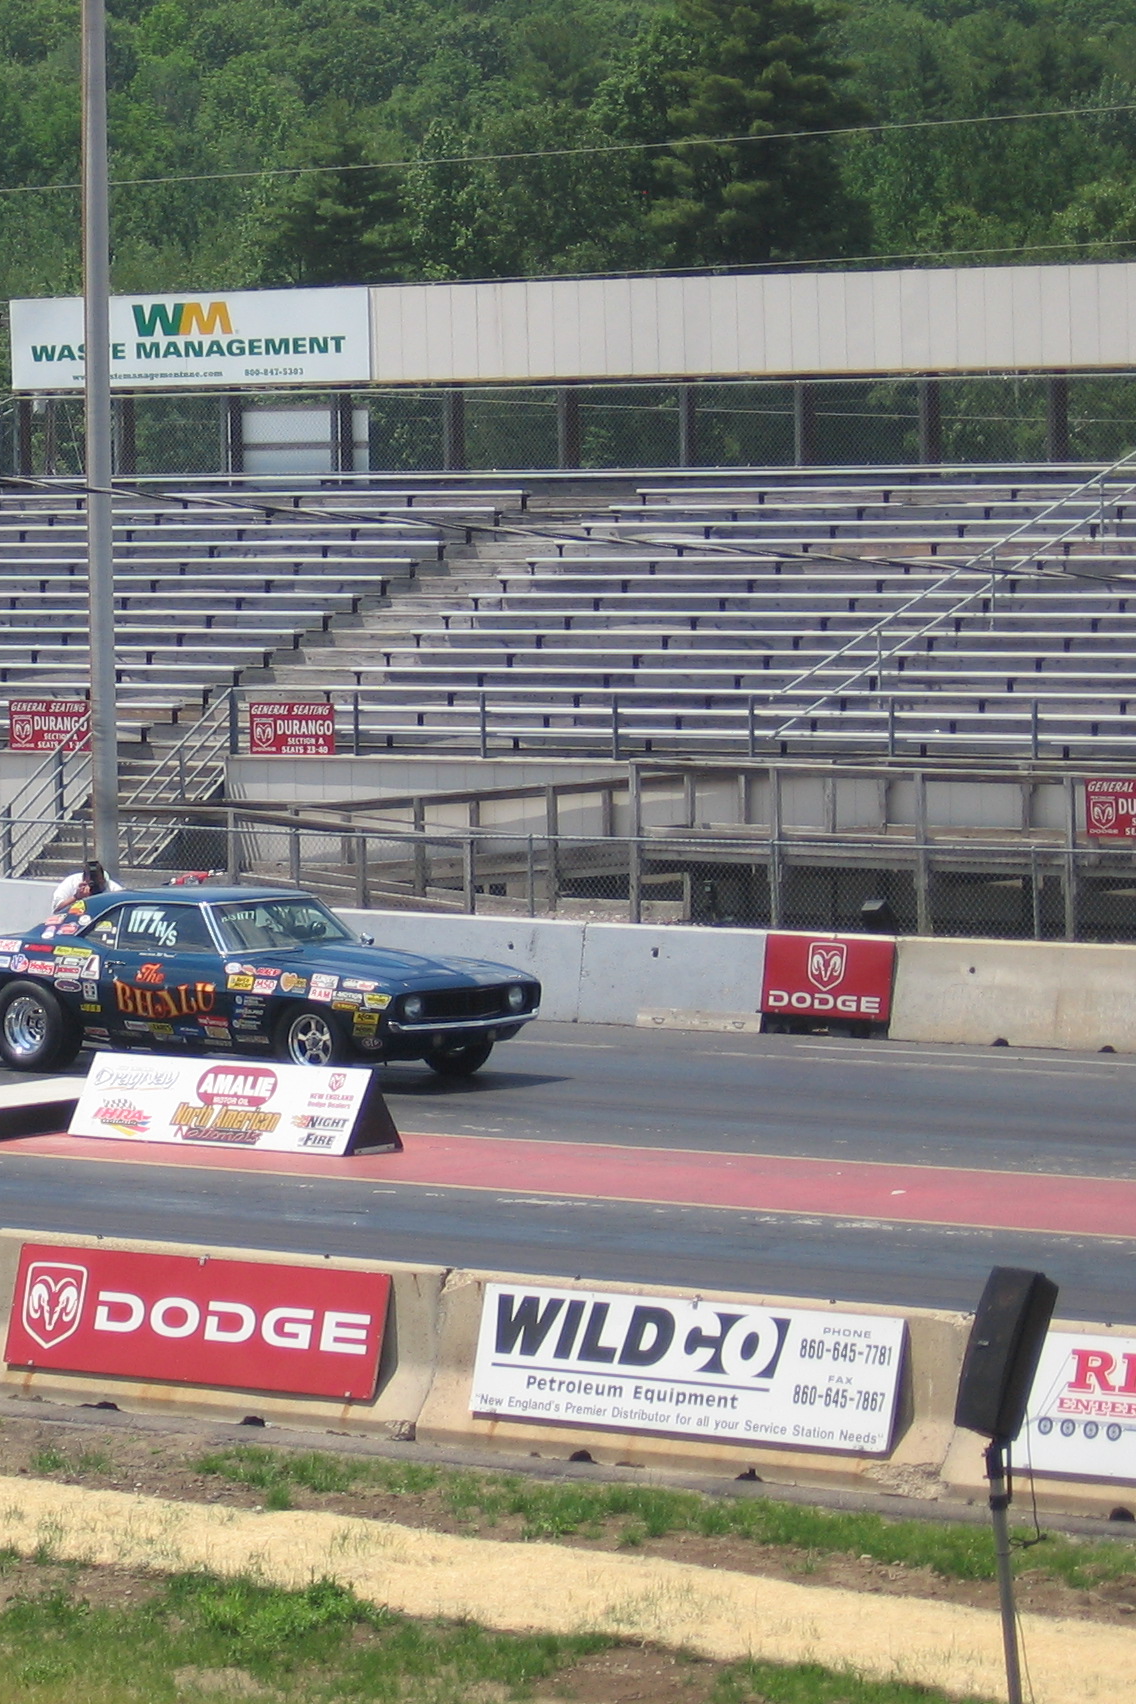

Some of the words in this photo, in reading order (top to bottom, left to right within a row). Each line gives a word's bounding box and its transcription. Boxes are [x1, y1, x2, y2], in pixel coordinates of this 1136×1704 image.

[131, 302, 233, 337] WM
[31, 342, 126, 363] WASE
[136, 336, 346, 360] MANAGEMENT
[11, 702, 46, 712] GENERAL
[49, 702, 86, 713] SEATING
[251, 705, 289, 715] GENERAL
[291, 705, 330, 715] SEATING
[34, 716, 88, 732] DURANGO
[276, 719, 333, 736] DURANGO
[44, 733, 68, 741] SECTIO
[287, 737, 316, 745] SECTION
[281, 746, 304, 754] SEATS
[1088, 781, 1134, 793] GENERAL
[135, 962, 165, 985] The
[310, 988, 331, 999] RAM
[768, 990, 881, 1014] DODGE
[94, 1067, 180, 1090] Dragway
[198, 1073, 276, 1097] AMALIE
[213, 1096, 237, 1105] MOTOR
[238, 1098, 249, 1106] OIL
[169, 1102, 215, 1128] North
[211, 1105, 282, 1134] American
[305, 1115, 350, 1129] NIGHT
[303, 1132, 336, 1147] FIRE
[94, 1291, 371, 1355] DODGE
[494, 1293, 791, 1379] WILDCO
[823, 1327, 872, 1339] PHONE
[799, 1338, 893, 1366] 860-645-7781
[827, 1375, 854, 1385] FAX
[526, 1375, 623, 1398] Petroleum
[633, 1385, 739, 1411] Equipment
[792, 1384, 886, 1412] 860-645-7867
[1057, 1397, 1136, 1417] ENTER
[508, 1396, 560, 1413] England's
[565, 1402, 608, 1417] Premier
[611, 1406, 671, 1424] Distributor
[675, 1412, 692, 1426] for
[696, 1415, 710, 1428] all
[714, 1419, 740, 1431] your
[744, 1420, 788, 1435] Service
[792, 1424, 835, 1440] Station
